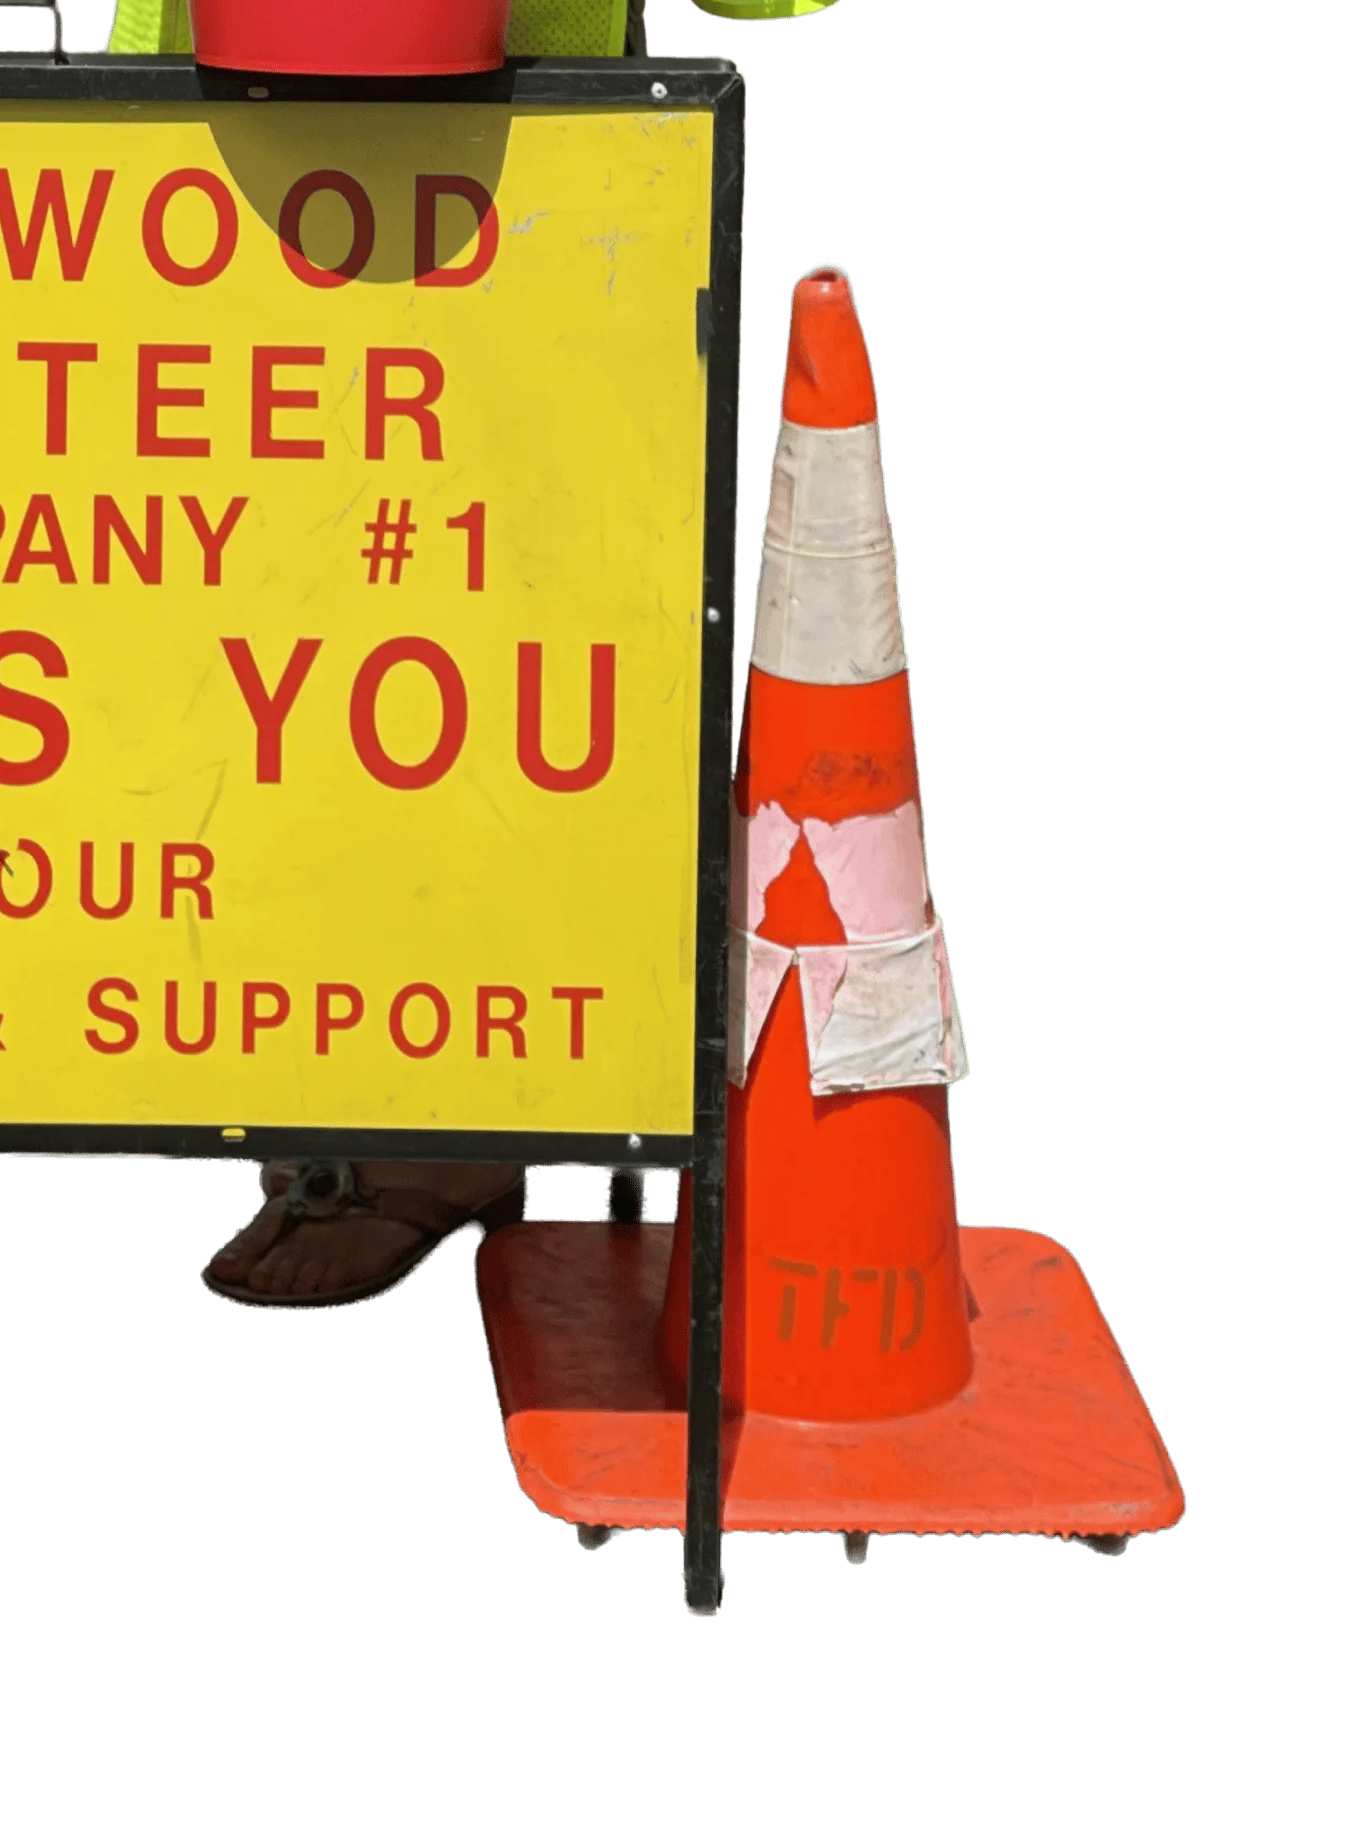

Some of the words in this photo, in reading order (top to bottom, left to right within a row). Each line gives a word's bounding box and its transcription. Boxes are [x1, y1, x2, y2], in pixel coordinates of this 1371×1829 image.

[361, 498, 487, 592] #1
[220, 636, 617, 793] YOU
[85, 977, 605, 1060] SUPPORT
[768, 1256, 927, 1353] TFD
